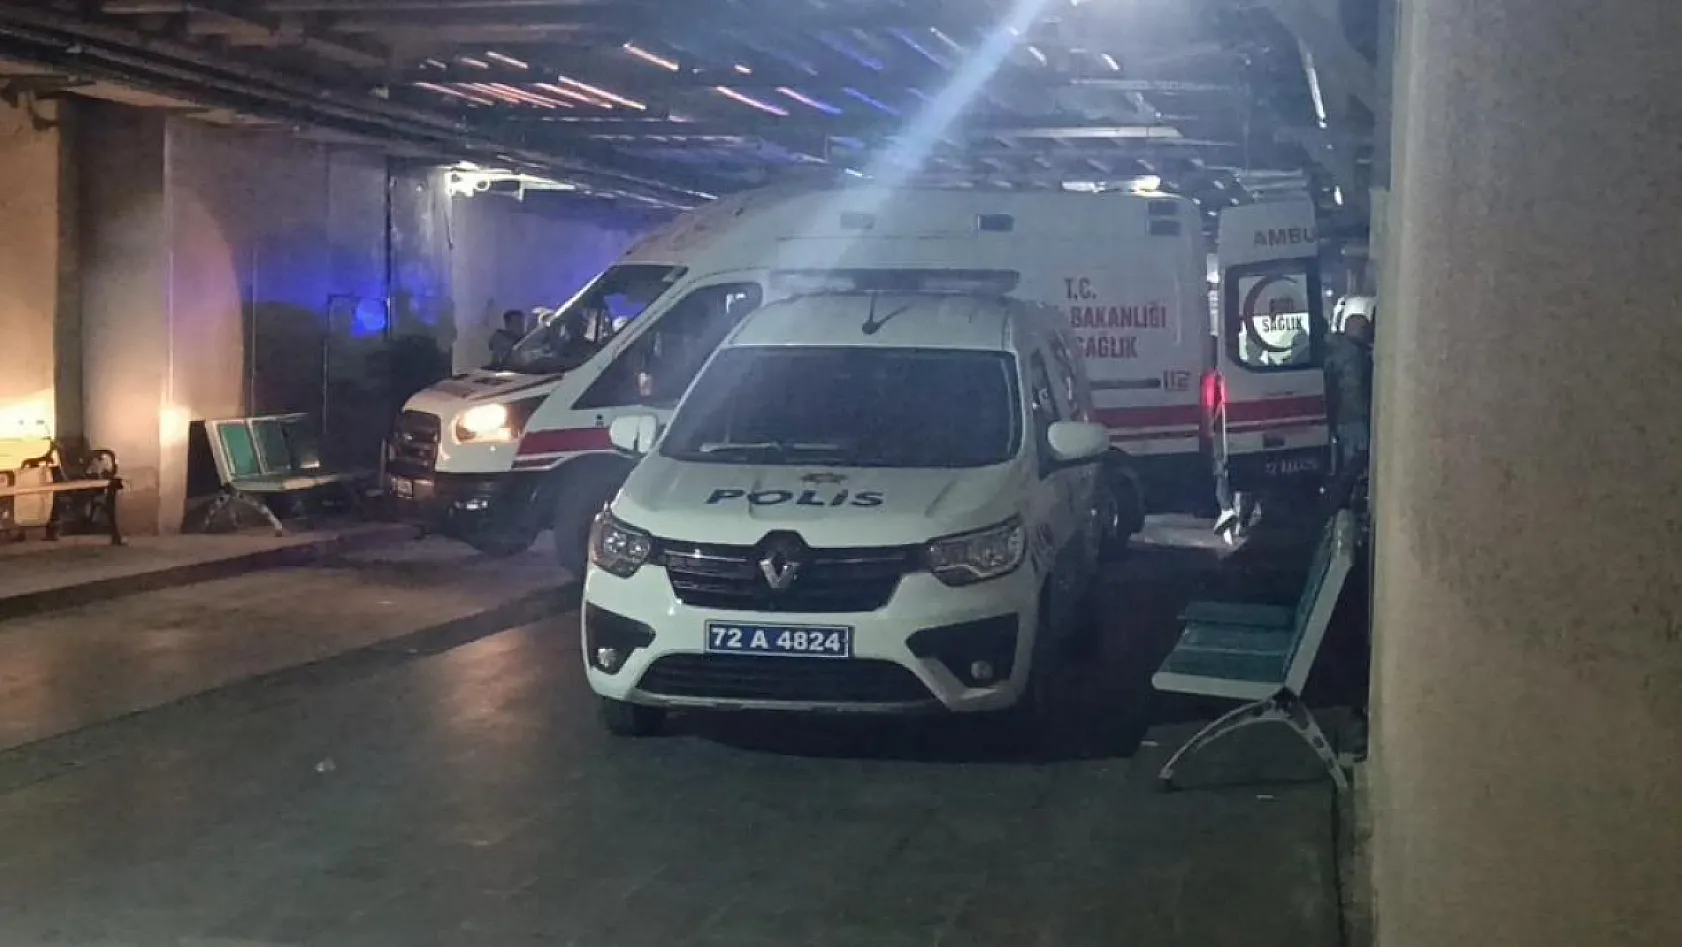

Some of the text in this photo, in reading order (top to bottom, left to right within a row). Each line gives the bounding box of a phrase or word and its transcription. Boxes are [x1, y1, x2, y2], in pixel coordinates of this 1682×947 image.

[1064, 277, 1098, 299] T.C.
[1069, 301, 1166, 329] BAKANLIĞI
[711, 627, 841, 652] 72 A 4824
